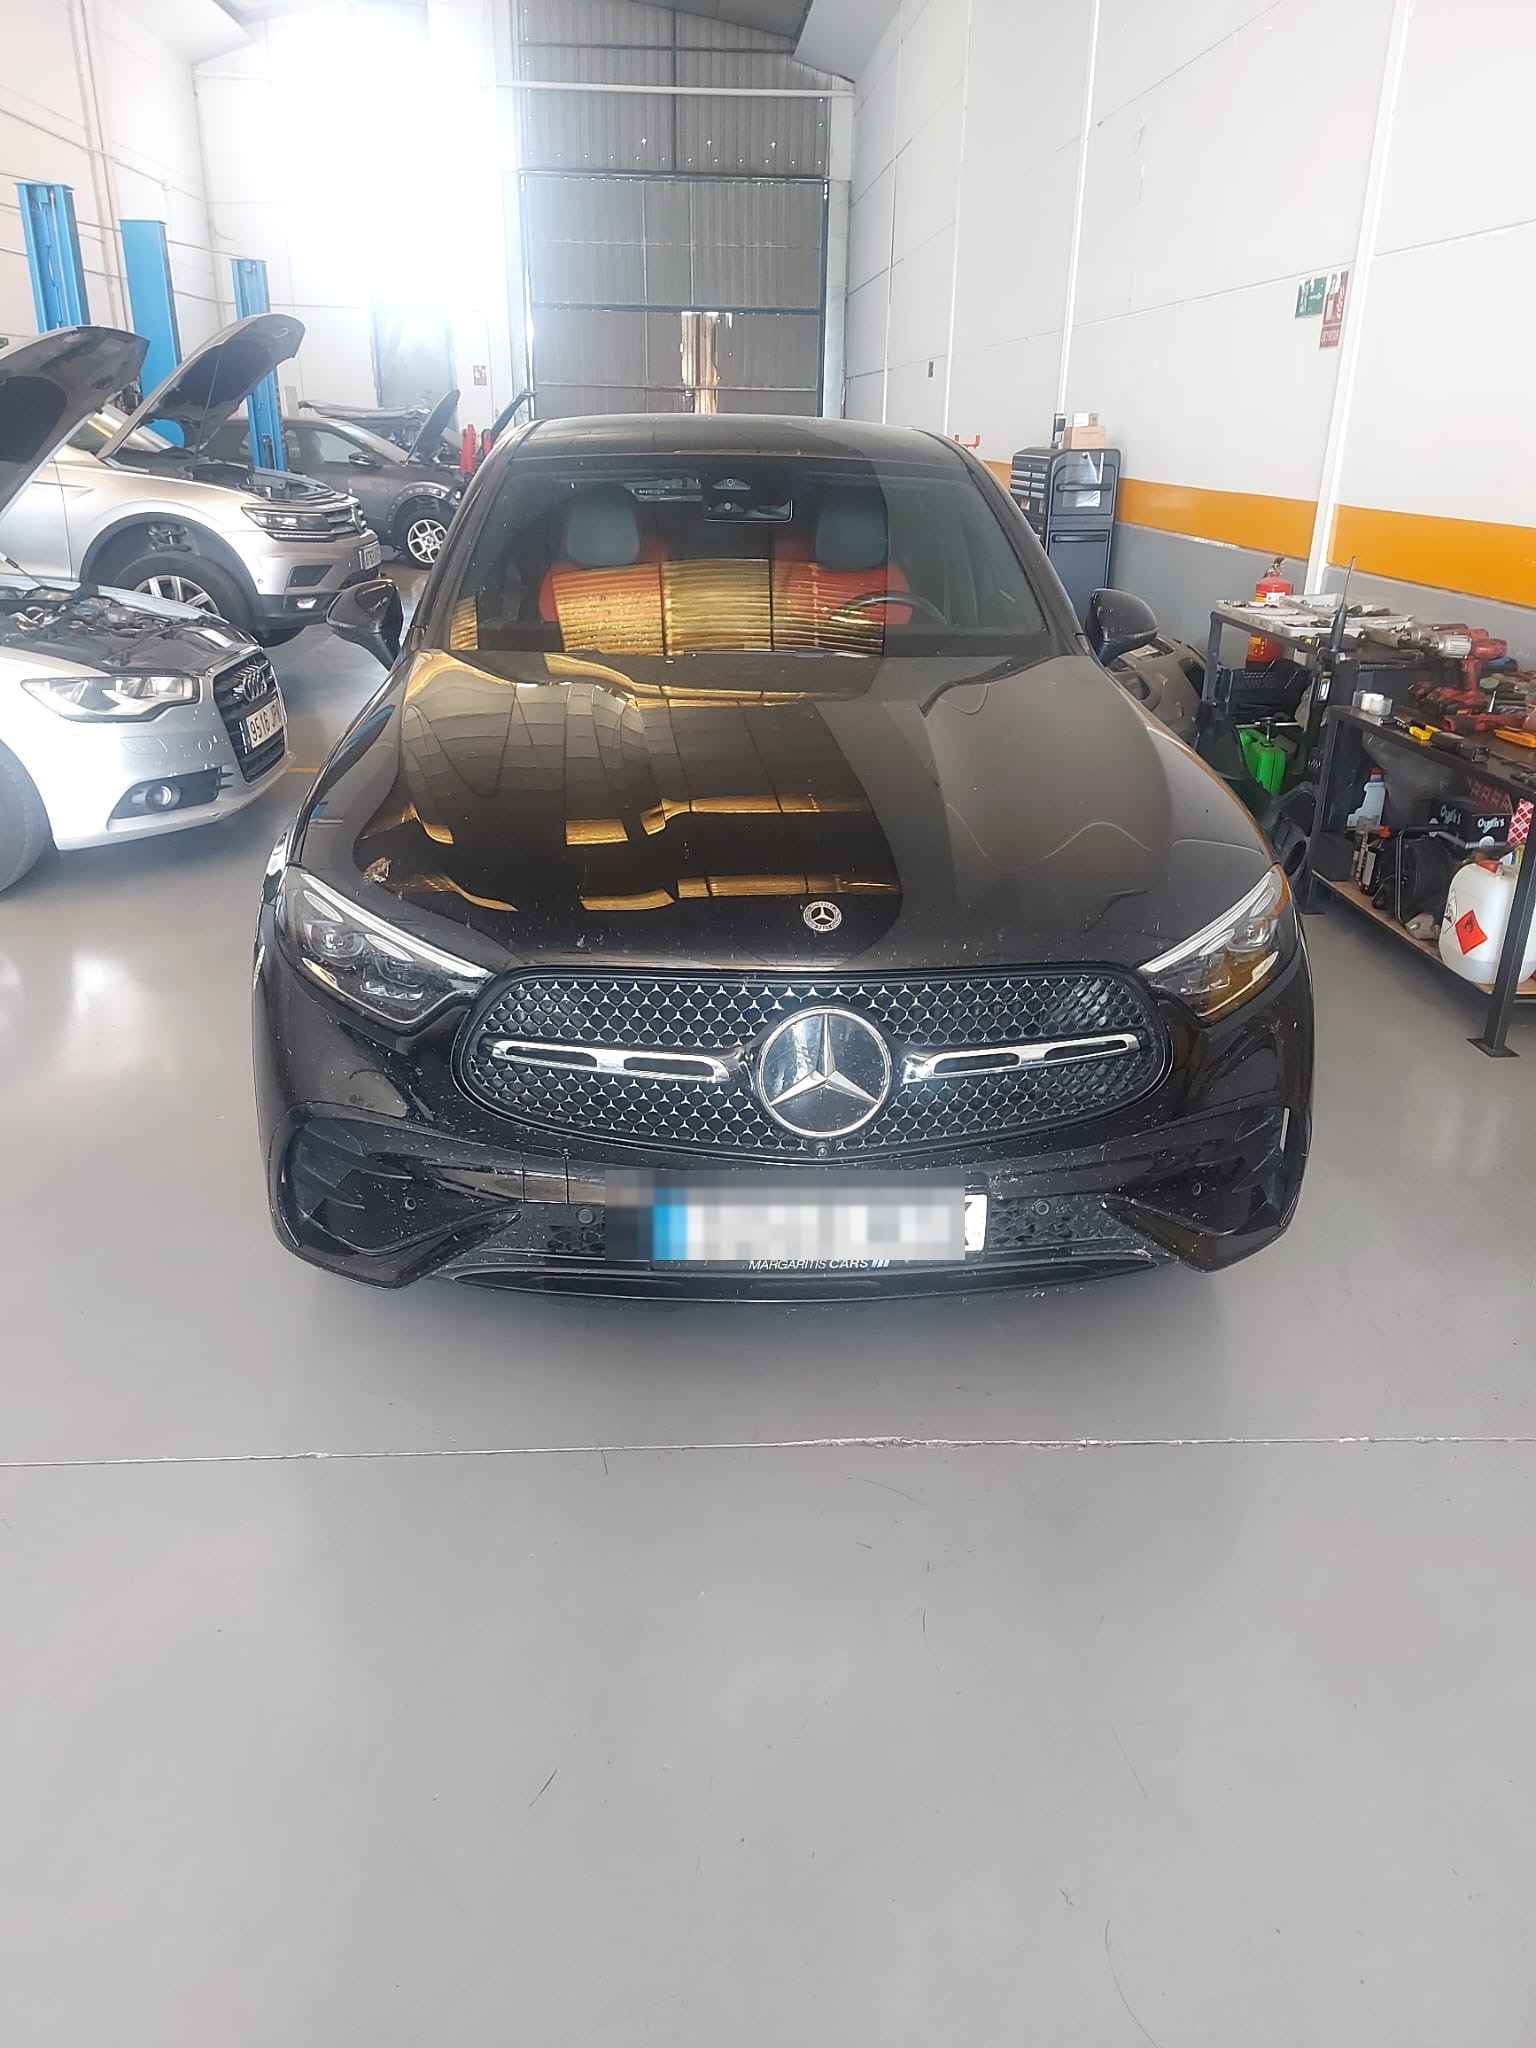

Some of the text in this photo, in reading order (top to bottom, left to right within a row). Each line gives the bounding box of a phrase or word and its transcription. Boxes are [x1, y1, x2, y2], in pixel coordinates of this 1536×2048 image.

[249, 710, 270, 742] 9516
[748, 1259, 869, 1270] MARGARITIS CARS
